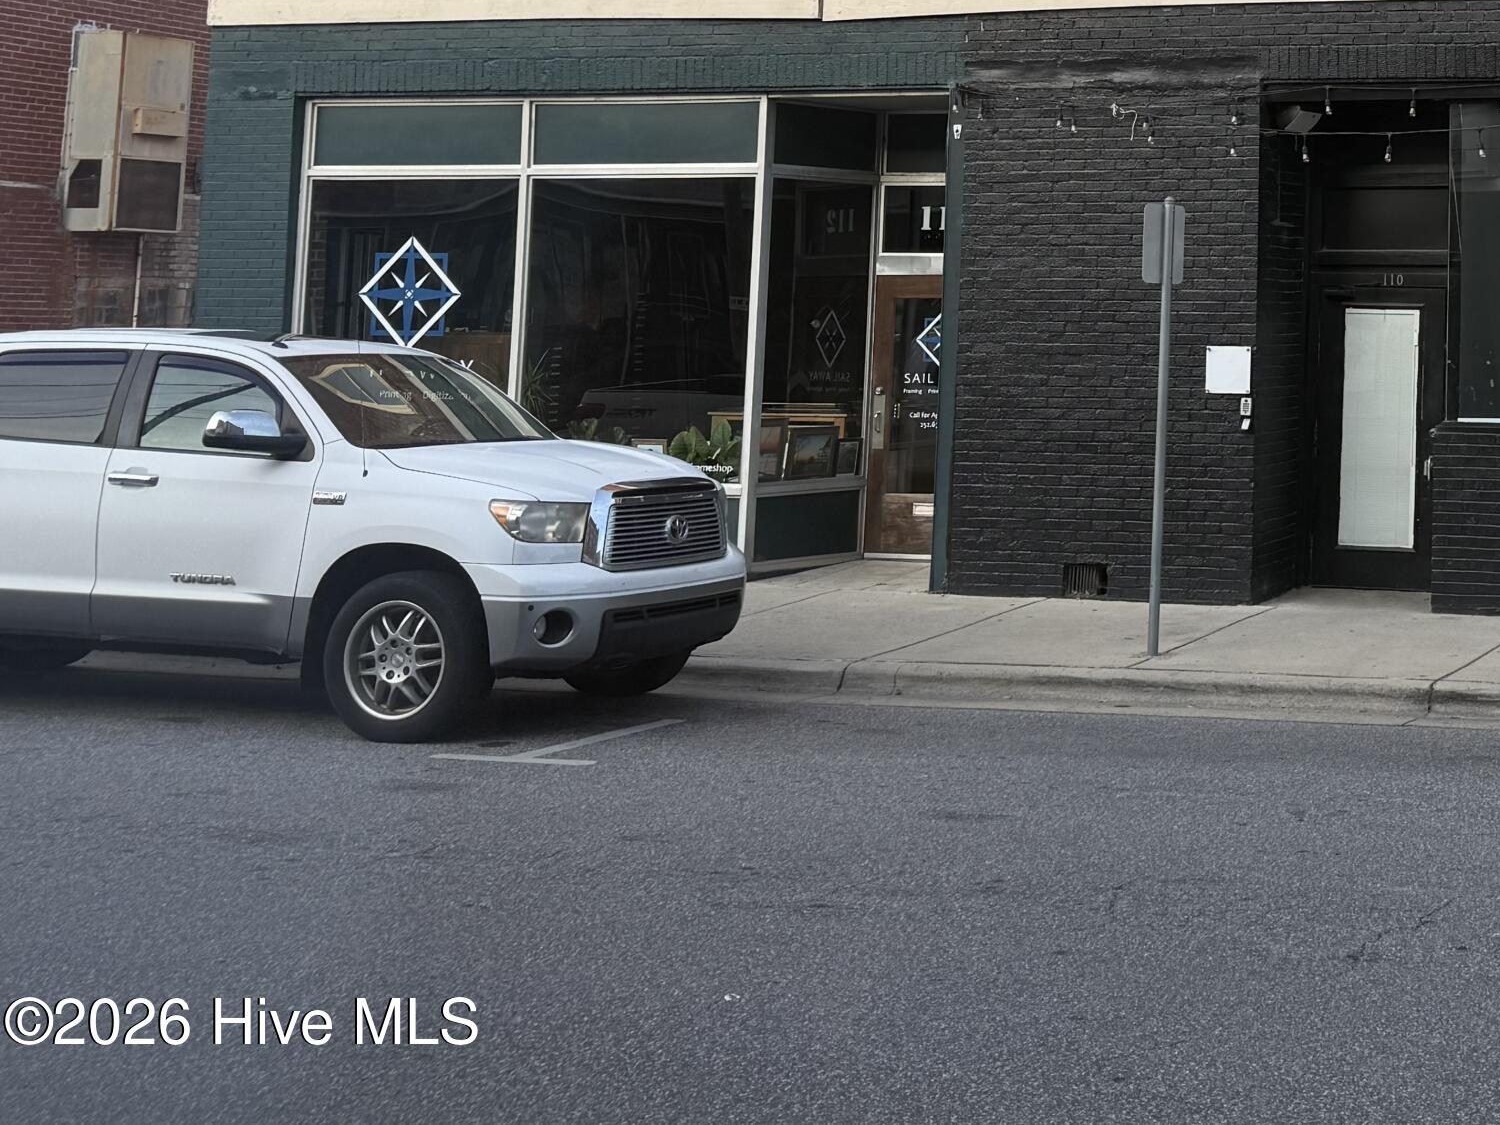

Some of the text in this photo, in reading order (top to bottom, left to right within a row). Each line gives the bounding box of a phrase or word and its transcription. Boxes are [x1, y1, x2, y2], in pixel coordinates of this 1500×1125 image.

[1383, 273, 1403, 286] 110
[903, 373, 934, 384] SAIL
[169, 572, 236, 586] TUNDRA
